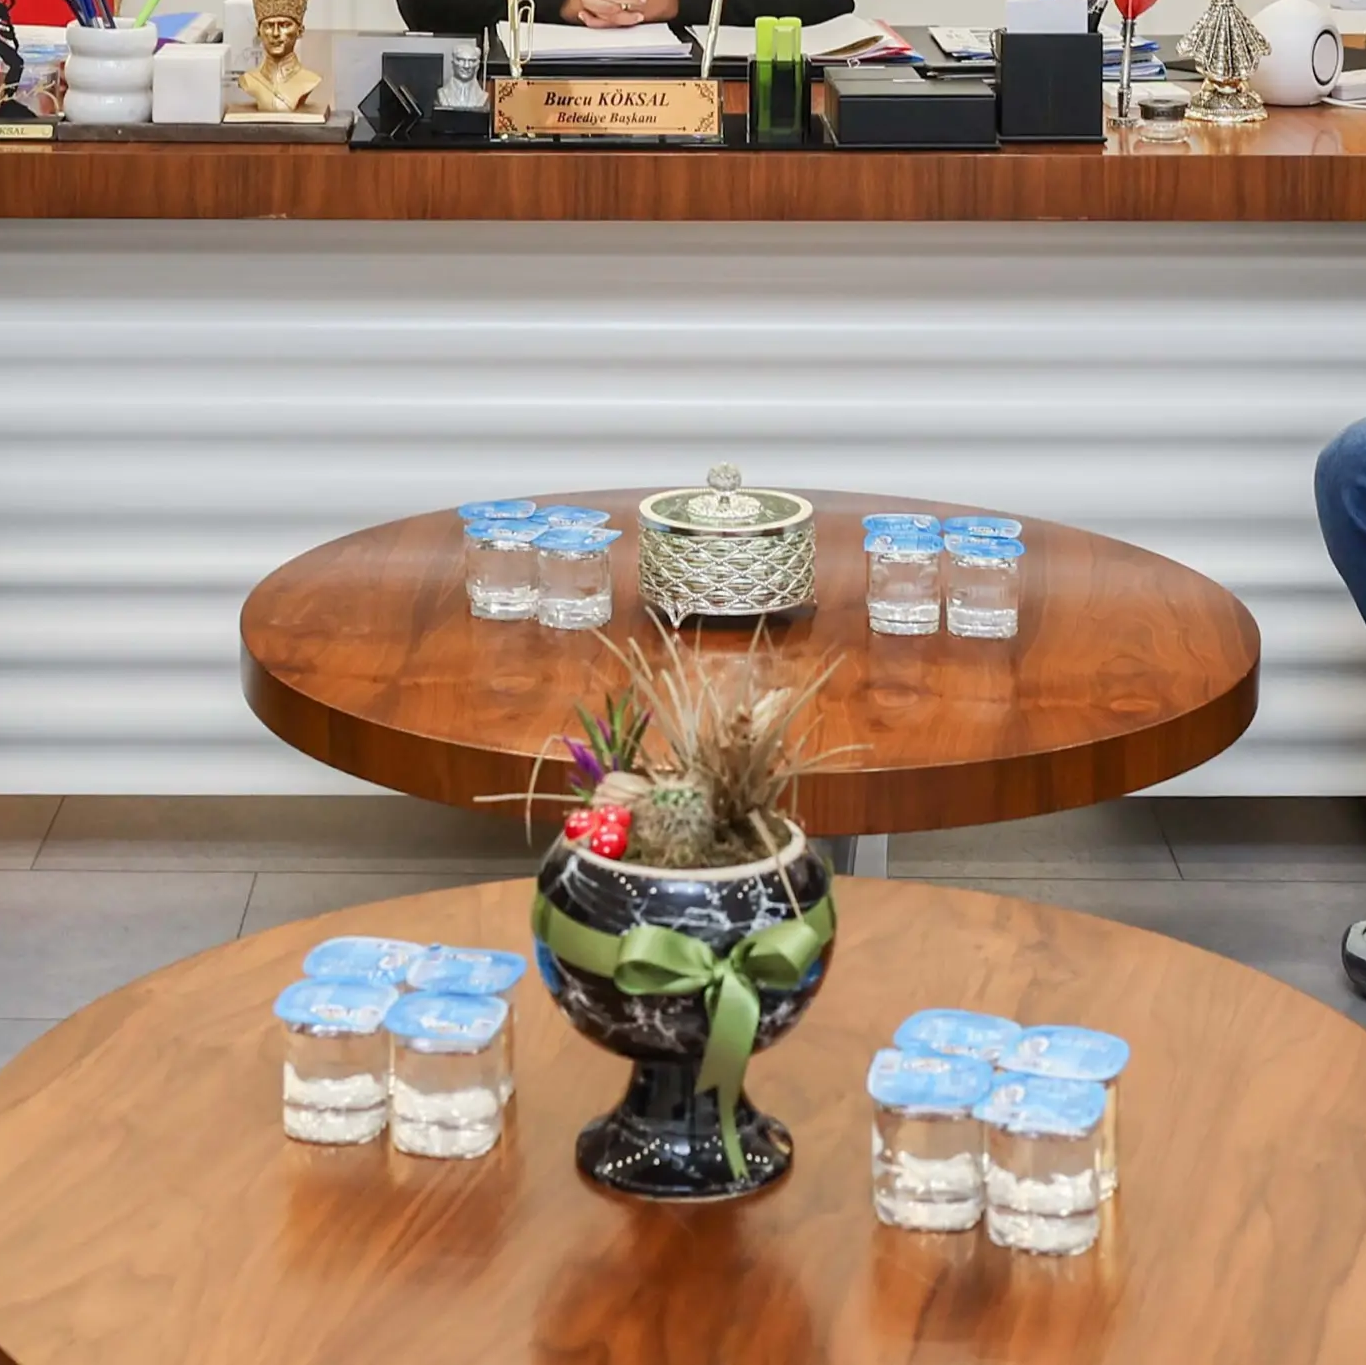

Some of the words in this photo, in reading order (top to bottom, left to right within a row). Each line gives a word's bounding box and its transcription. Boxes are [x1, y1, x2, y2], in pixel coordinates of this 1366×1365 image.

[544, 91, 592, 107] Burcu
[598, 89, 670, 107] KÖKSAL
[557, 111, 606, 126] Belediye
[609, 111, 657, 126] Başkanı
